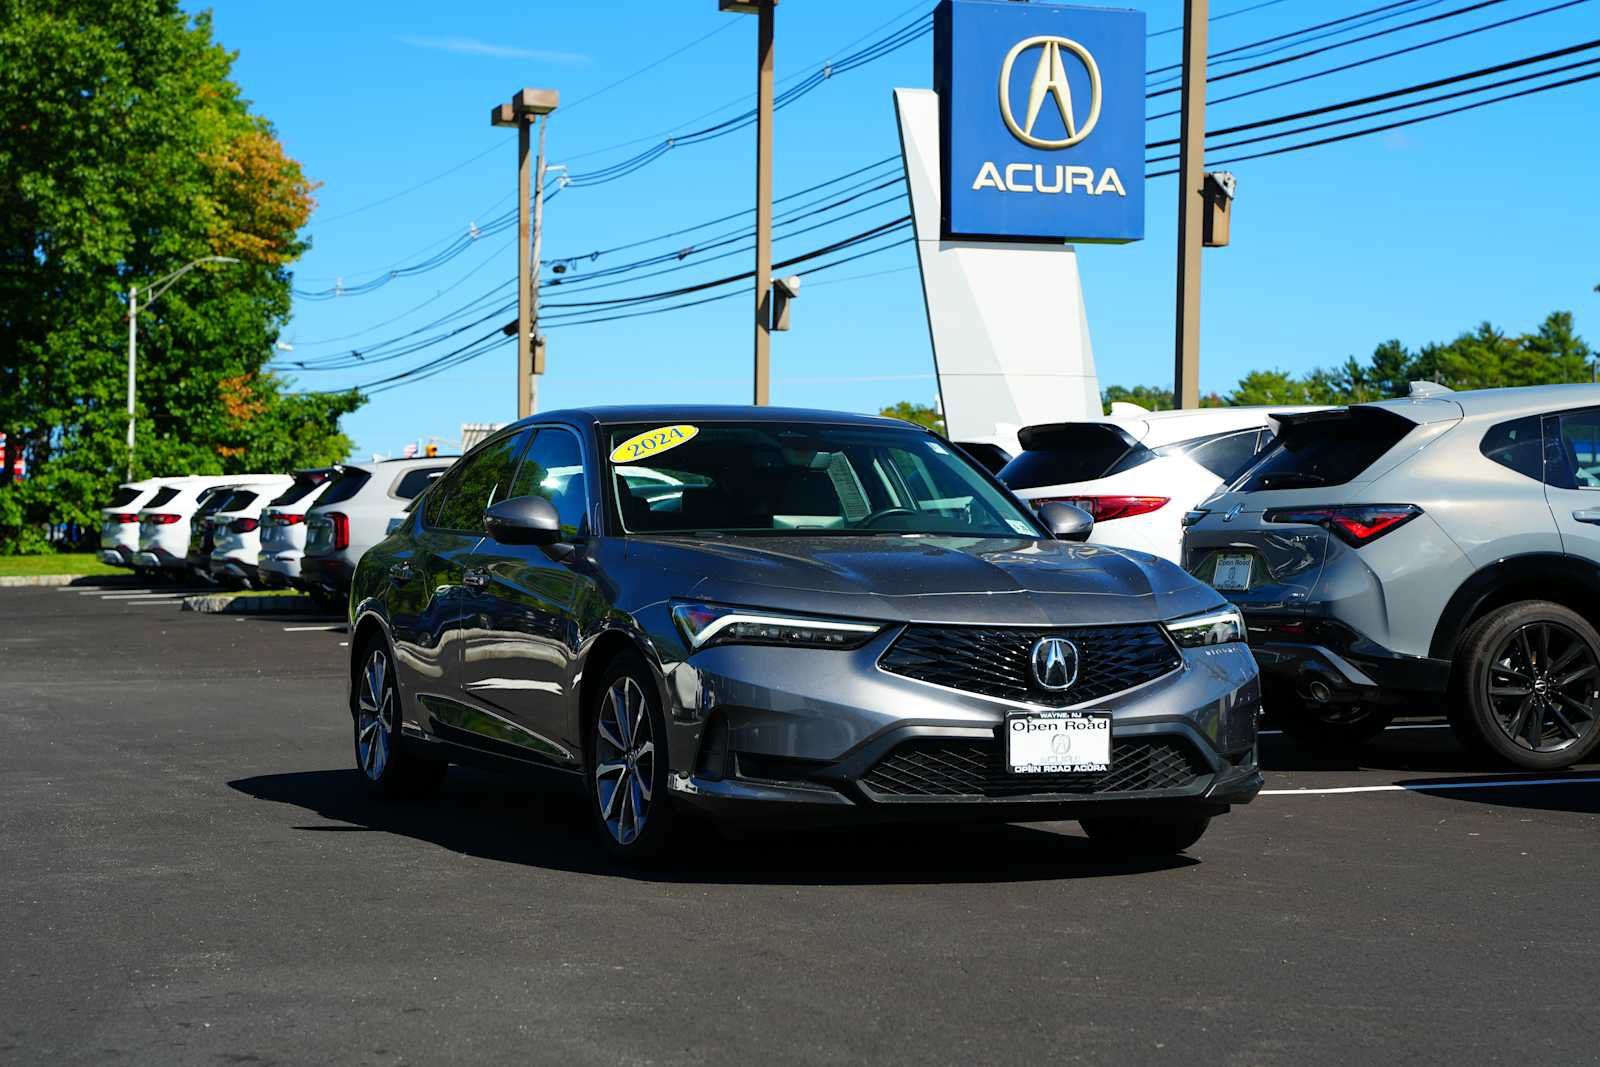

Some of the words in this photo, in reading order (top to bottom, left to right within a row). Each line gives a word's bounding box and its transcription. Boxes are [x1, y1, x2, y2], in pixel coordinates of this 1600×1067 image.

[971, 161, 1127, 196] ACURA
[627, 428, 684, 457] 2024
[1012, 721, 1058, 733] Open
[1065, 720, 1107, 731] Road
[1014, 765, 1041, 773] OPEN
[1043, 764, 1072, 773] ROAD
[1073, 764, 1107, 772] ACURA
